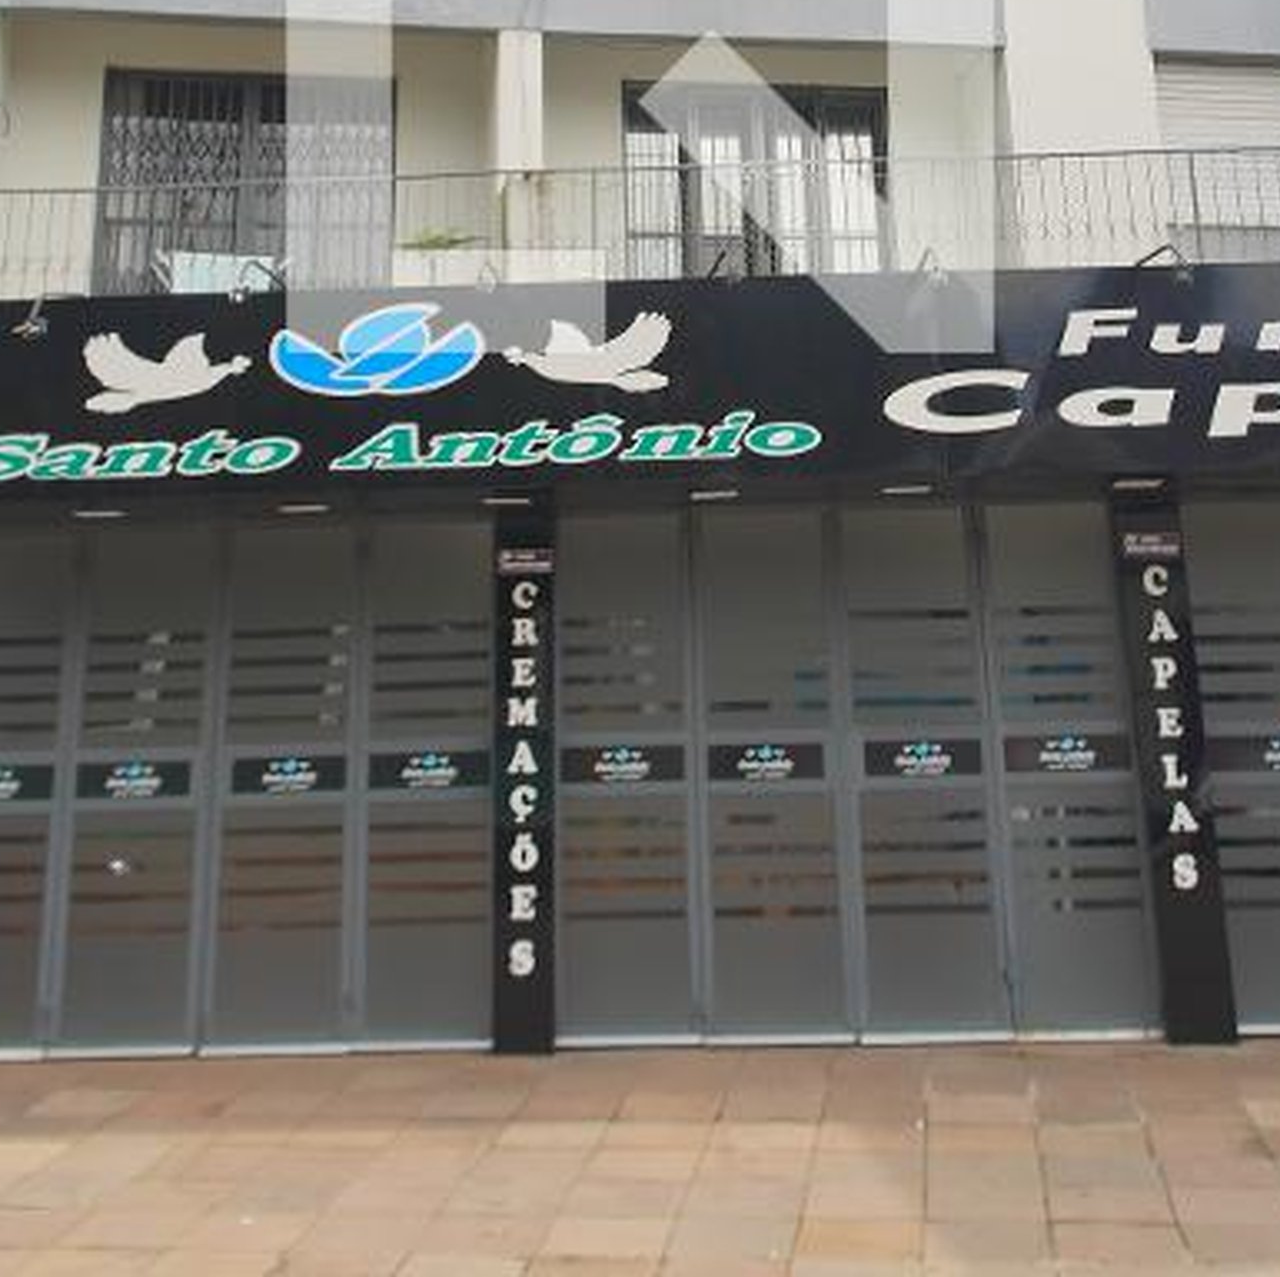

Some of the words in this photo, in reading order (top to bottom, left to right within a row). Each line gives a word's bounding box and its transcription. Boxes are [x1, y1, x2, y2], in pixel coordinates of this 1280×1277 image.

[329, 411, 822, 472] Antônio
[507, 581, 539, 976] CREMAÇÕES
[1143, 565, 1199, 890] CAPELAS
